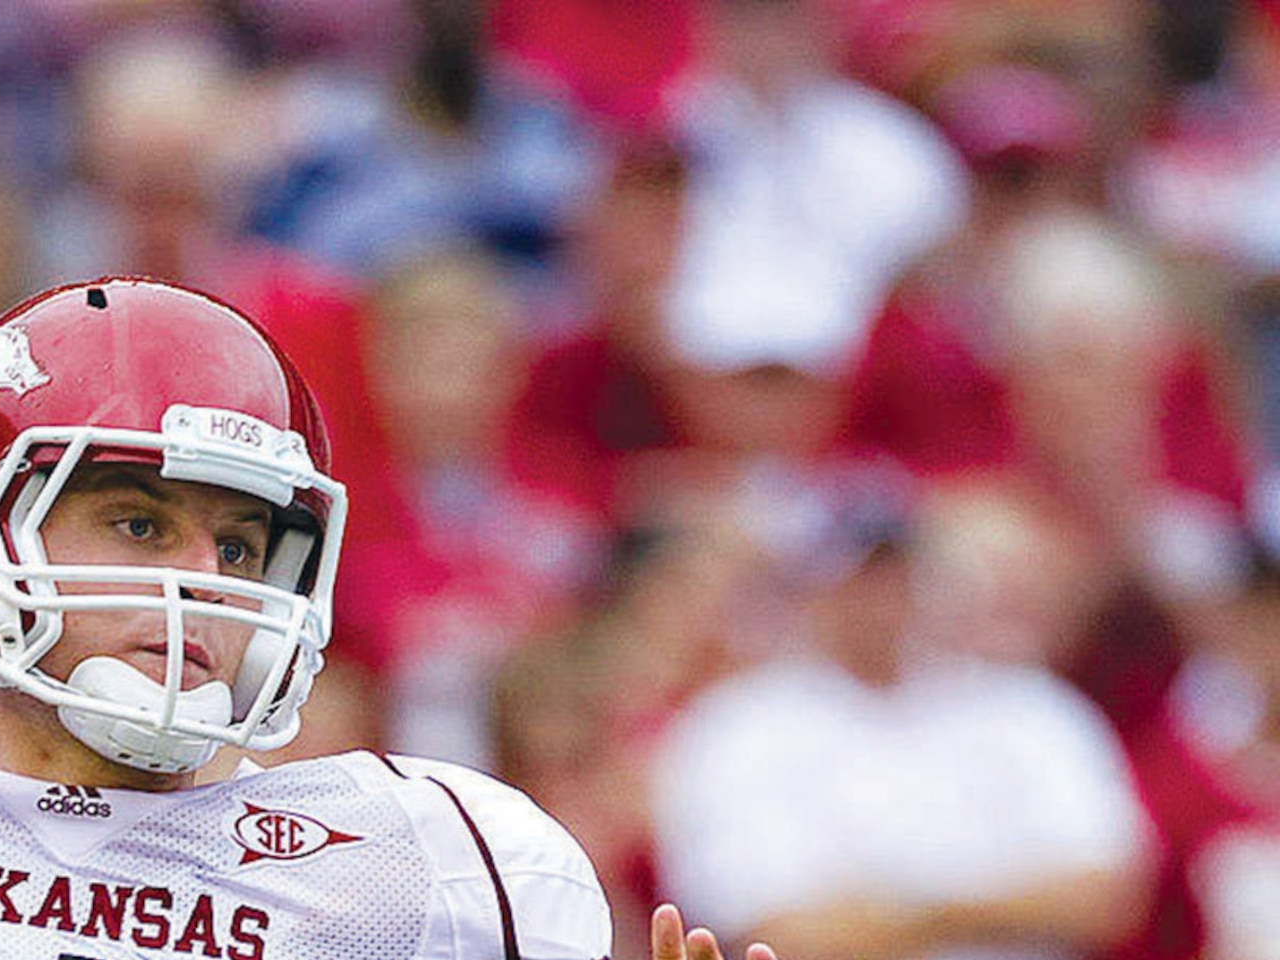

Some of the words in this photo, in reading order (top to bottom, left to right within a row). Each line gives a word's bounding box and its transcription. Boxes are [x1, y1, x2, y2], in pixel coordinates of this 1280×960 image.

[211, 414, 263, 447] HOGS
[37, 795, 112, 818] adidas
[255, 815, 305, 853] SEC
